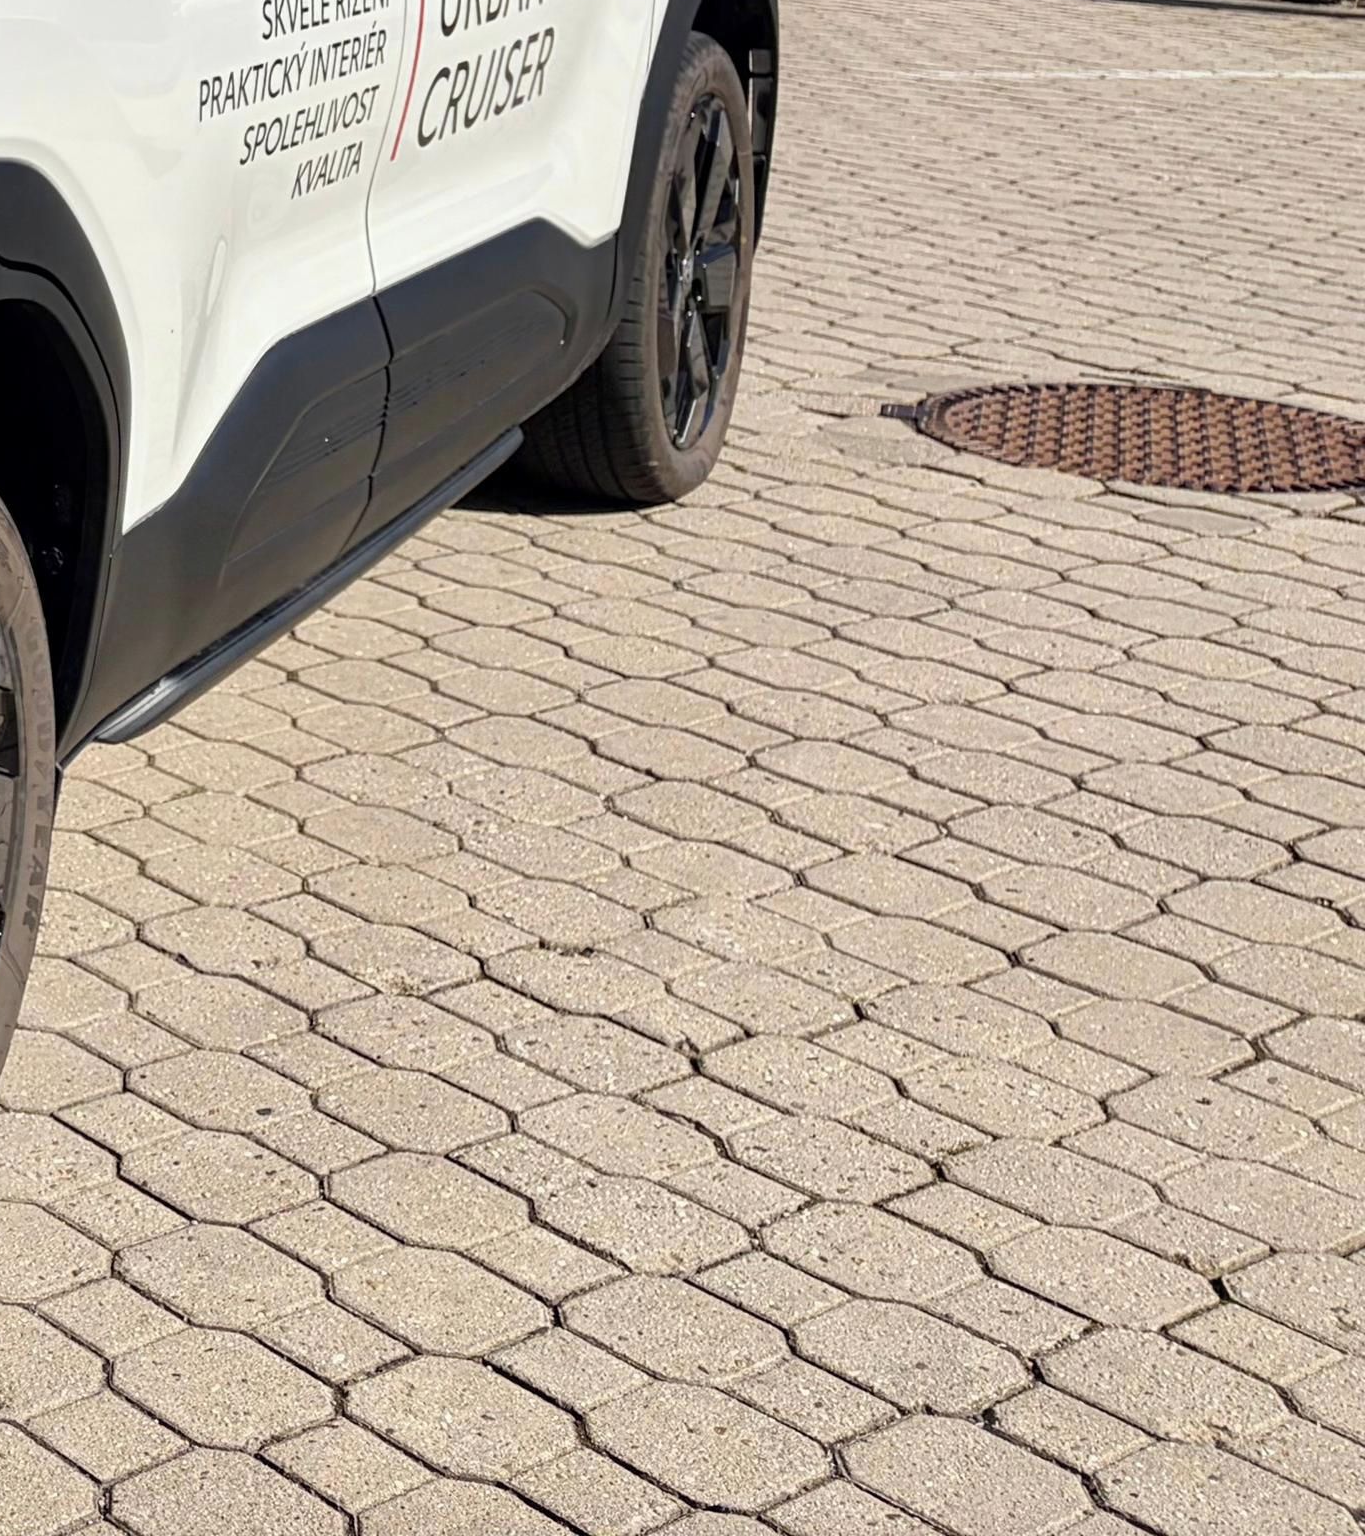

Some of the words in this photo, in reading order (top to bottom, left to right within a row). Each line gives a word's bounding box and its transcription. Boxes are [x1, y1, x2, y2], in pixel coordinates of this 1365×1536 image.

[199, 41, 309, 122] PRAKTICKÝ
[308, 21, 387, 88] INTERIÉR
[418, 27, 555, 148] CRUISER
[239, 84, 380, 165] SPOLEHLIVOST
[291, 141, 363, 200] KVALITA
